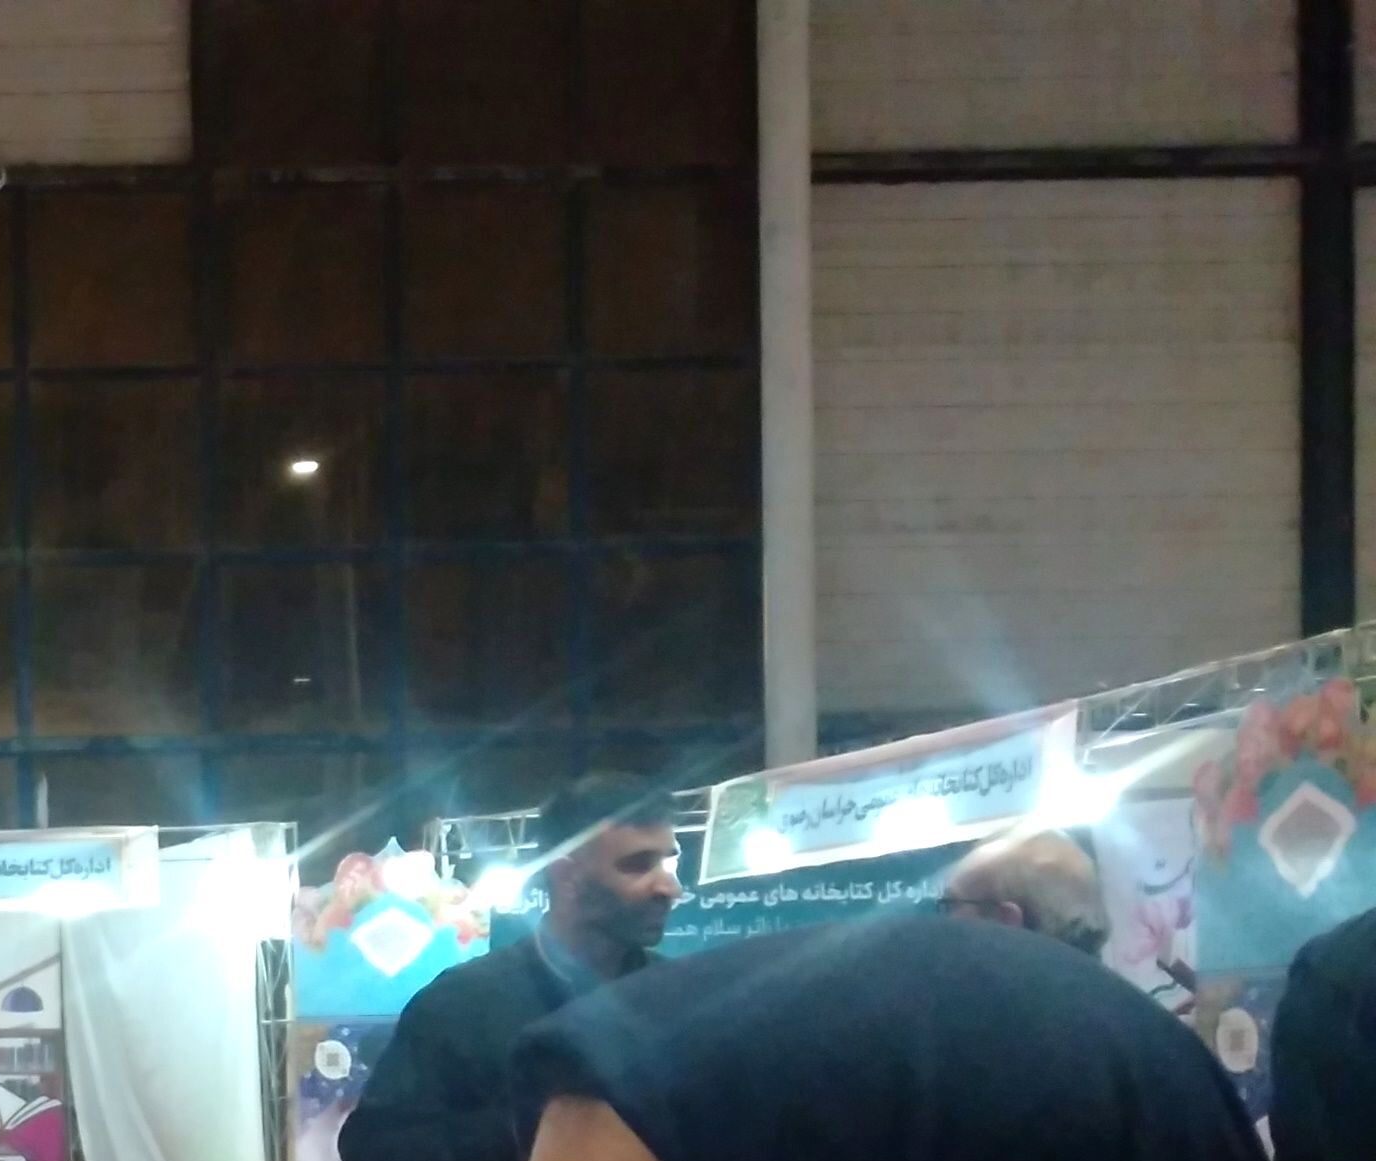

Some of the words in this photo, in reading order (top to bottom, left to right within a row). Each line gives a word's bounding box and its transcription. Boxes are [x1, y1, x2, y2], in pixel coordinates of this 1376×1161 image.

[699, 889, 760, 909] عمومی
[764, 883, 799, 908] های
[801, 881, 875, 907] کتابخانه
[877, 880, 903, 904] کل
[904, 880, 946, 904] اداره
